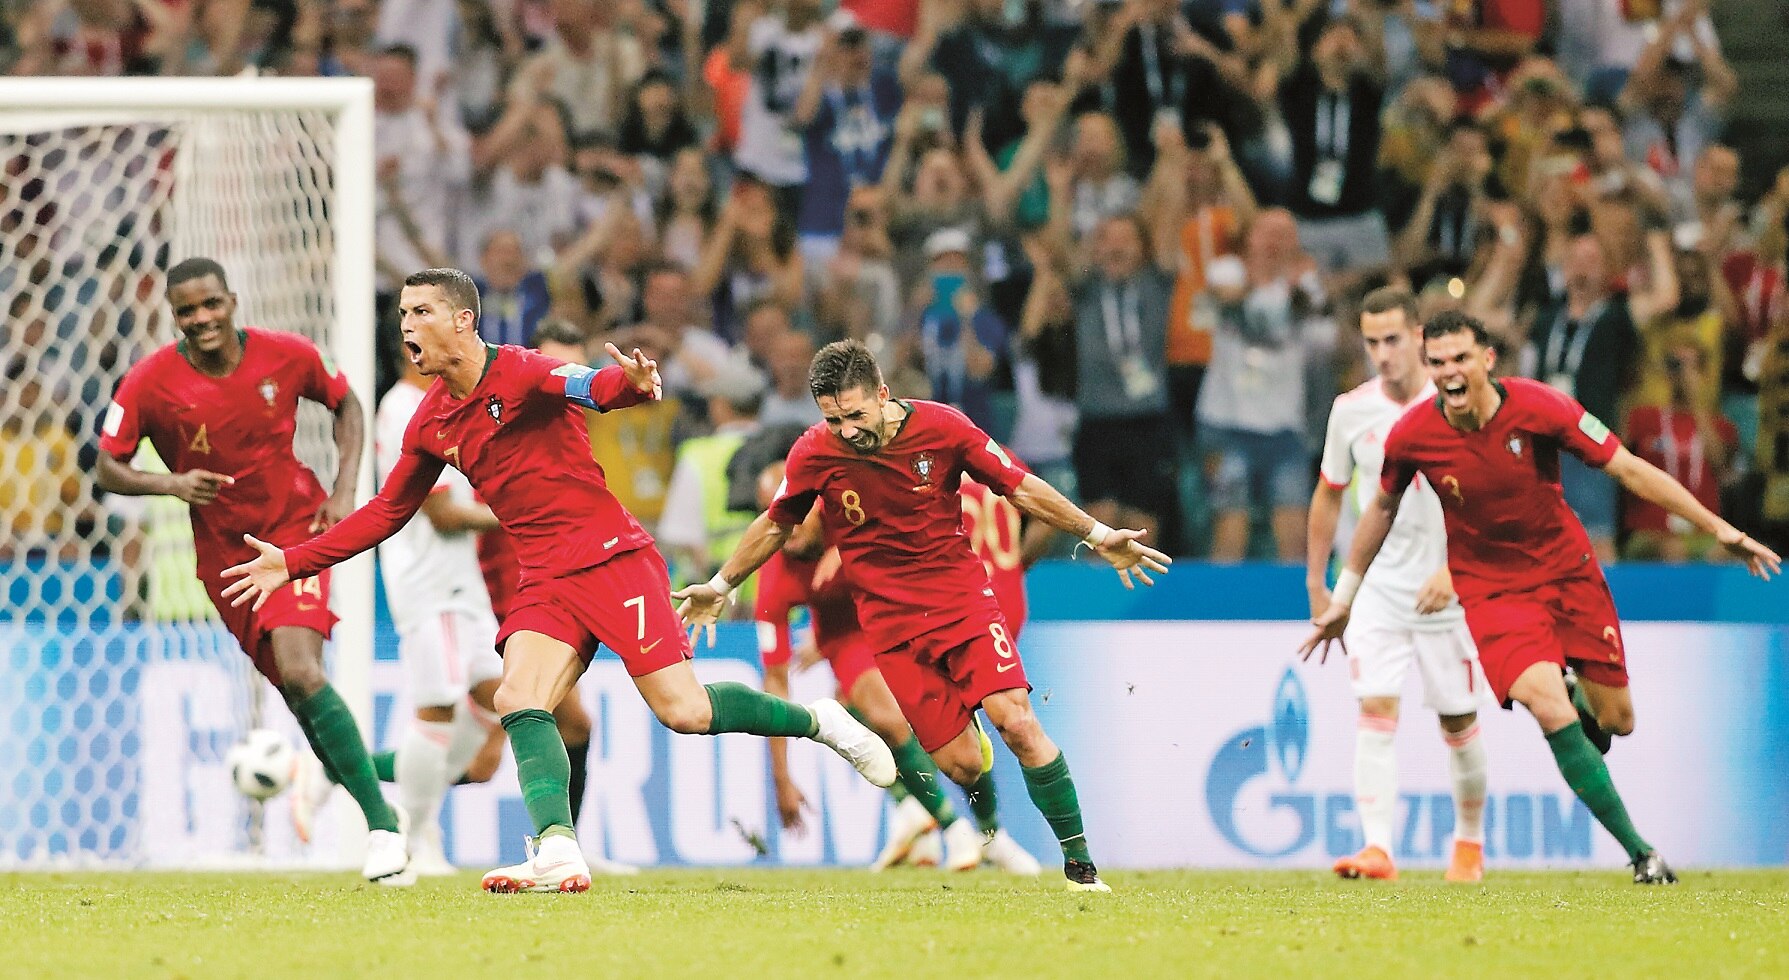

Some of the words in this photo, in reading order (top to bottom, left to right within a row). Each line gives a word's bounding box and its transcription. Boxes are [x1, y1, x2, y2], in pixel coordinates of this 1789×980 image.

[444, 446, 461, 470] 7
[841, 489, 866, 526] 8
[293, 575, 322, 600] 14
[623, 595, 645, 640] 7
[989, 622, 1013, 659] 8
[1325, 793, 1594, 858] GZPOM
